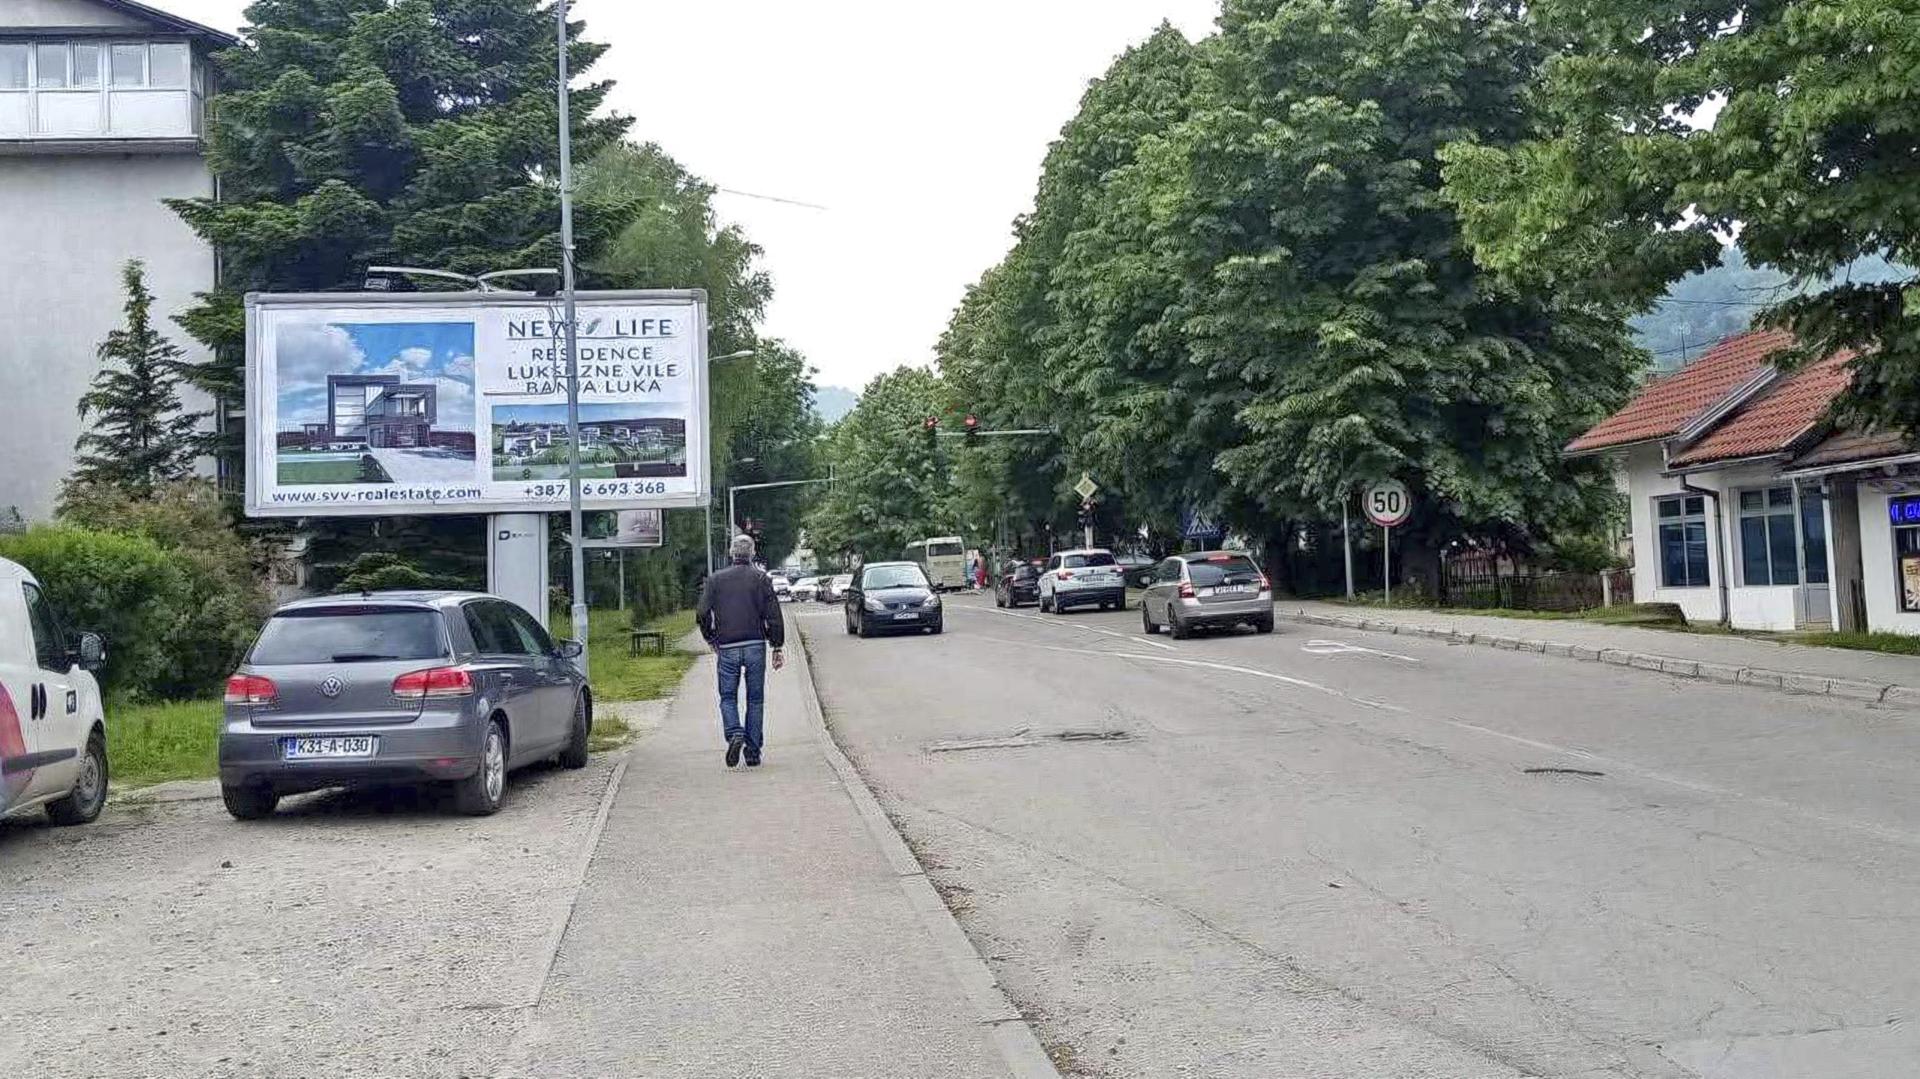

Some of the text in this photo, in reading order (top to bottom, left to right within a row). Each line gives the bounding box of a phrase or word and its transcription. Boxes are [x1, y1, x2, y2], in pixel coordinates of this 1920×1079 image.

[615, 319, 673, 336] LIFE
[532, 347, 653, 361] RESDENCE
[507, 364, 678, 380] LUKSZNE VILE
[605, 379, 662, 393] LUKA
[272, 488, 481, 502] www.svv-realestate.com
[524, 484, 566, 497] +387
[597, 483, 628, 494] 693
[634, 482, 665, 494] 368
[1374, 491, 1399, 513] 50
[298, 739, 369, 753] K31-A-030
